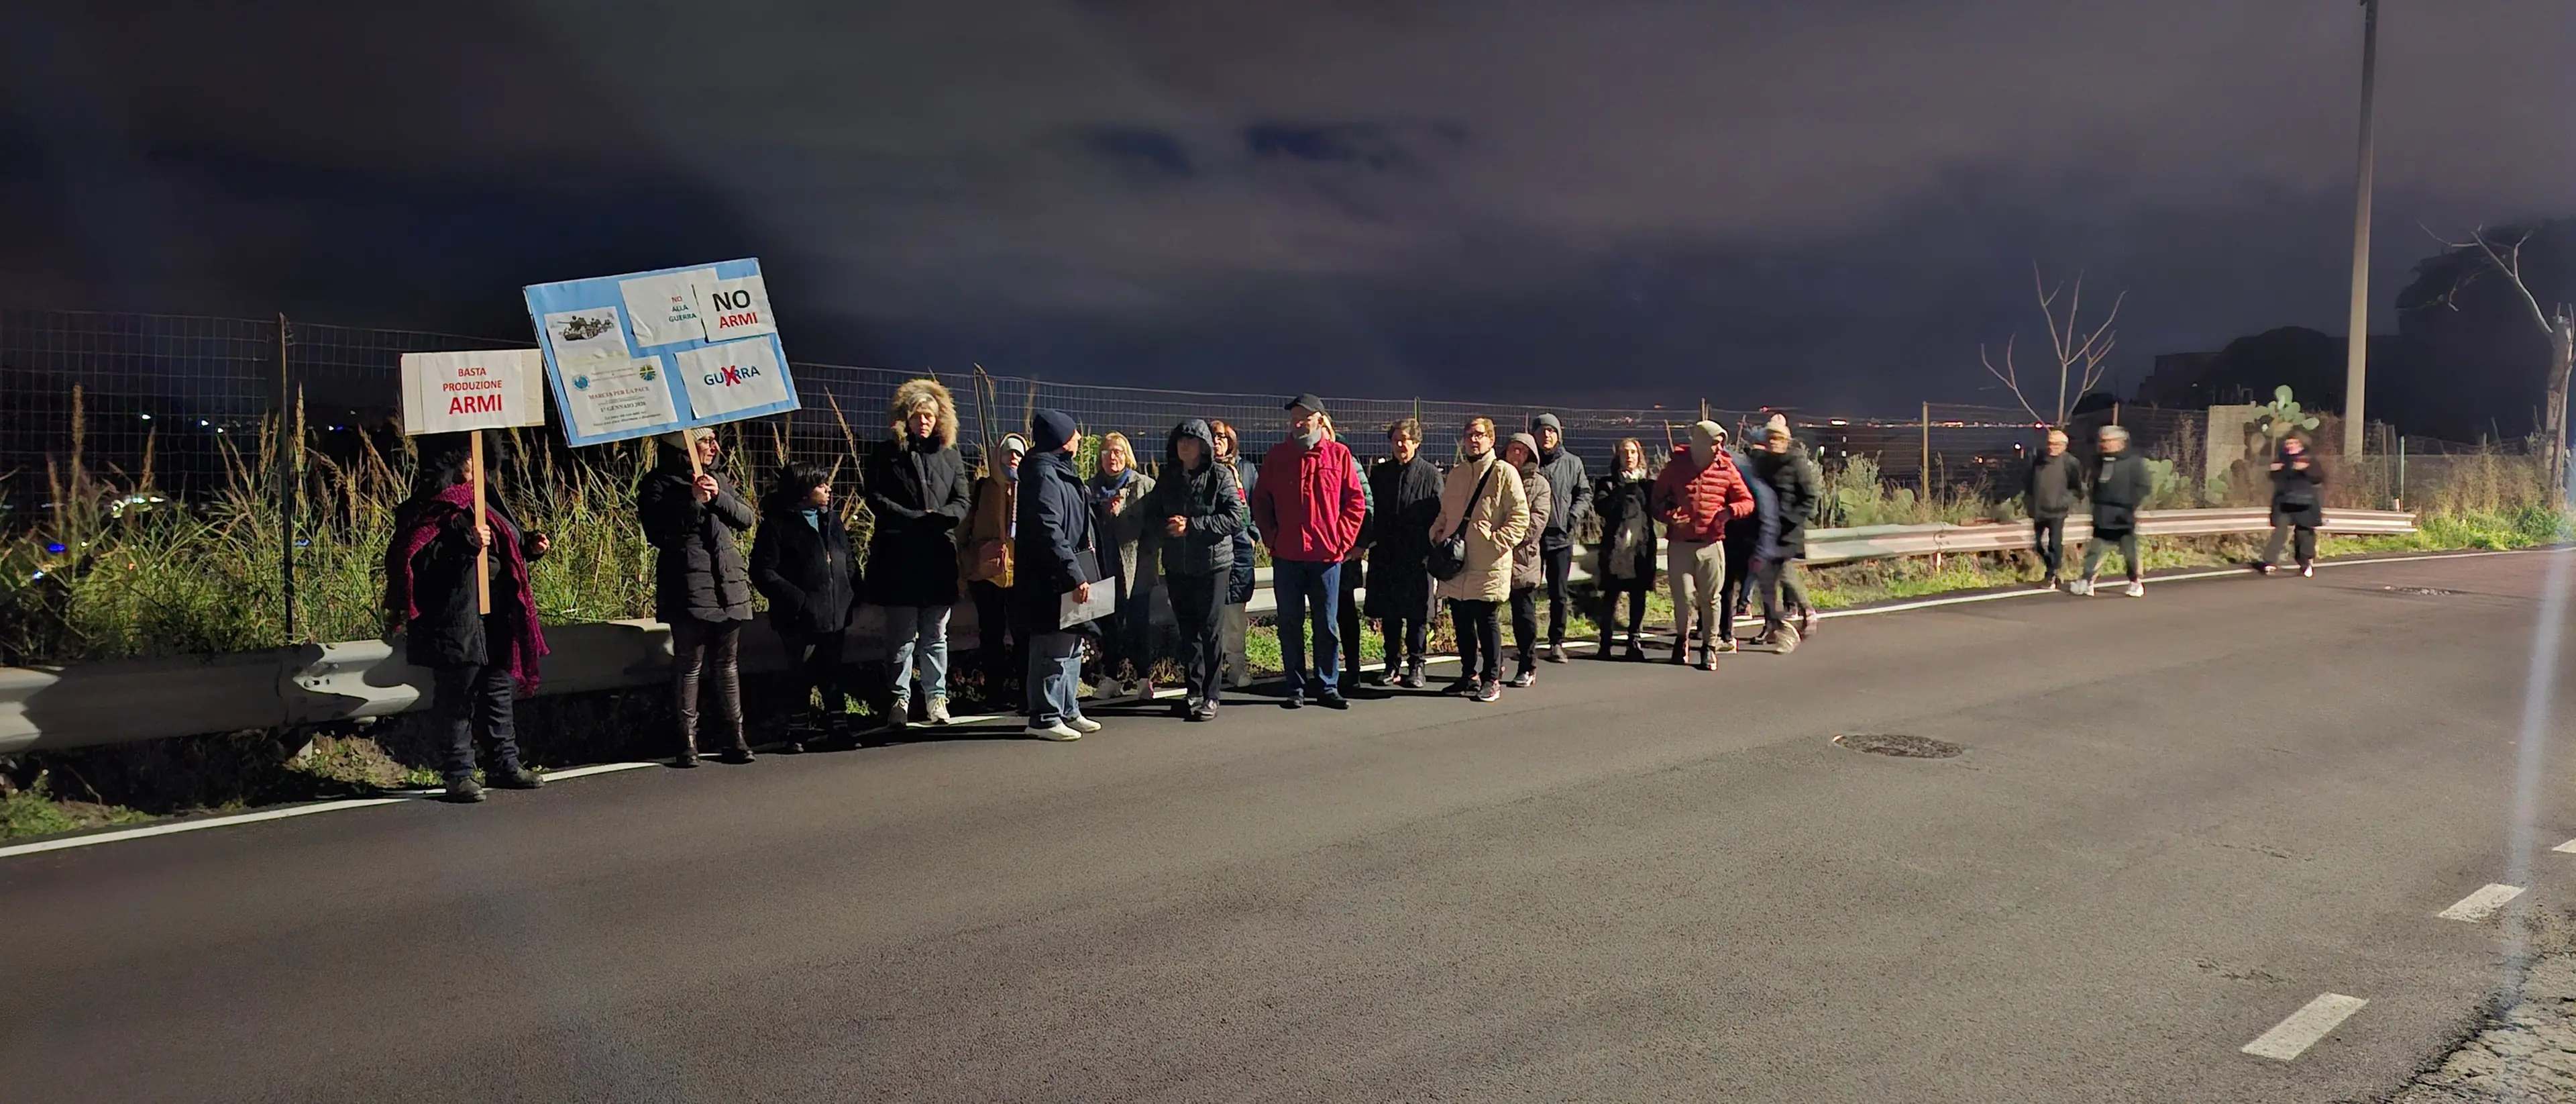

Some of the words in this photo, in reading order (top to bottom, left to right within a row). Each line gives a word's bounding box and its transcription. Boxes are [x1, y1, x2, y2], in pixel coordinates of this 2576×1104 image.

[712, 289, 751, 311] NO
[669, 313, 697, 322] GUERRA
[719, 312, 758, 329] ARMI
[458, 368, 486, 377] BASTA
[443, 380, 502, 391] PRODUZIONE
[449, 395, 502, 415] ARMI
